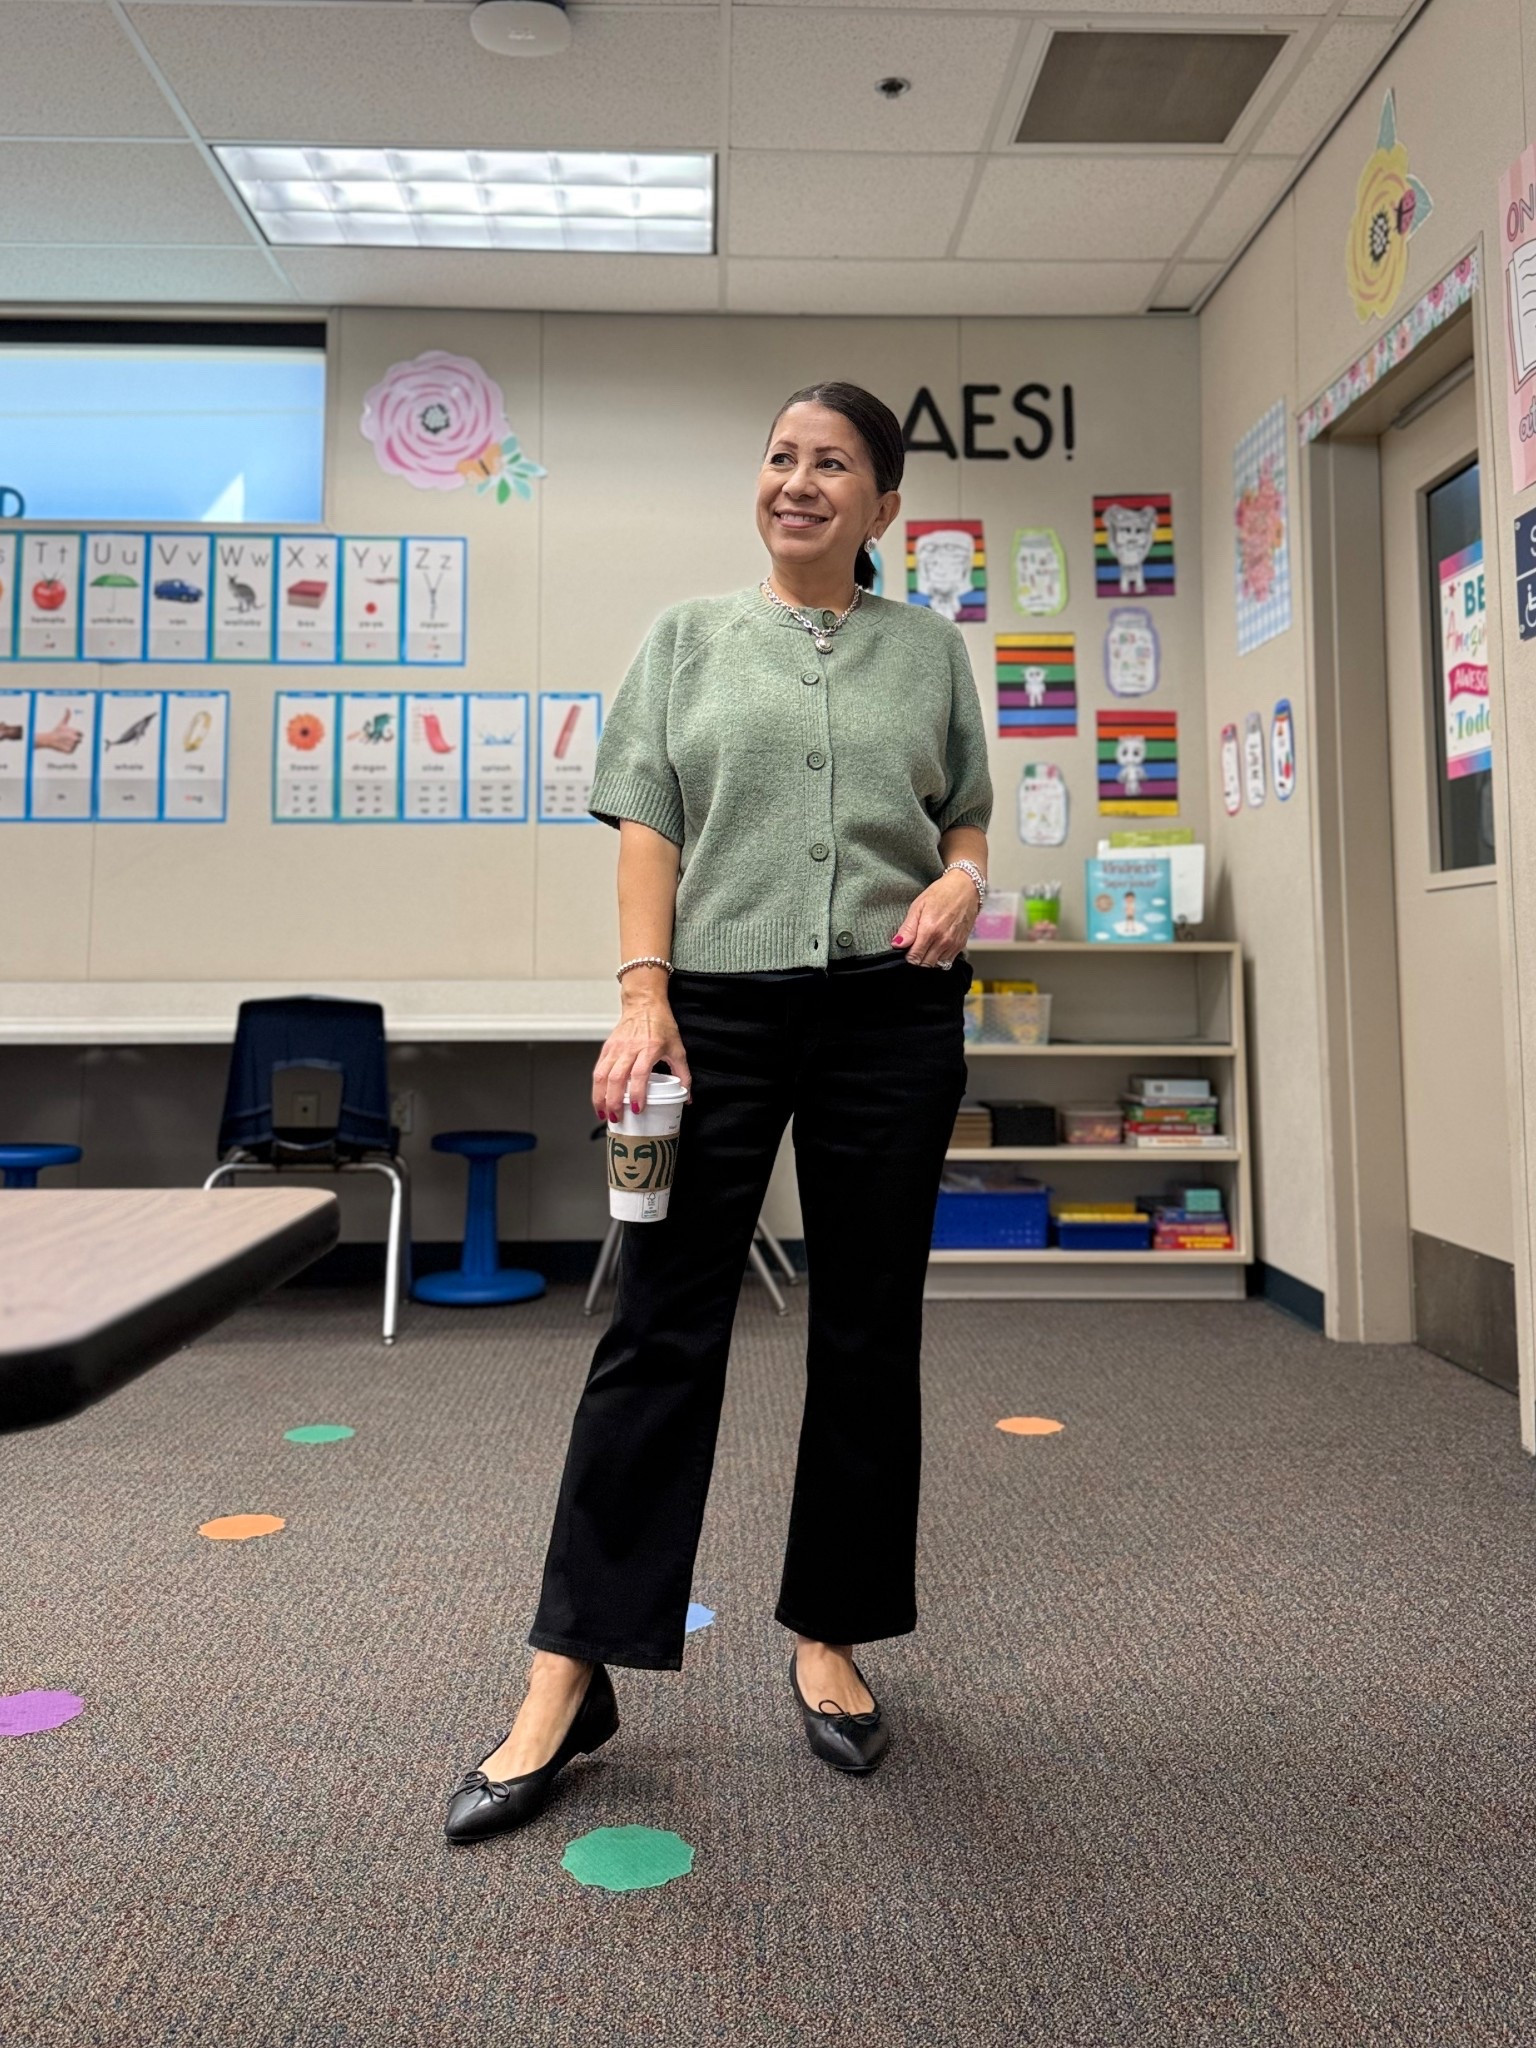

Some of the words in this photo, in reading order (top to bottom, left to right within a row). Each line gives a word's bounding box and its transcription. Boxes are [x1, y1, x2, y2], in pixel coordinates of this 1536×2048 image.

[902, 383, 1074, 461] AES!
[1464, 574, 1486, 618] BE
[1446, 610, 1488, 656] Amazi
